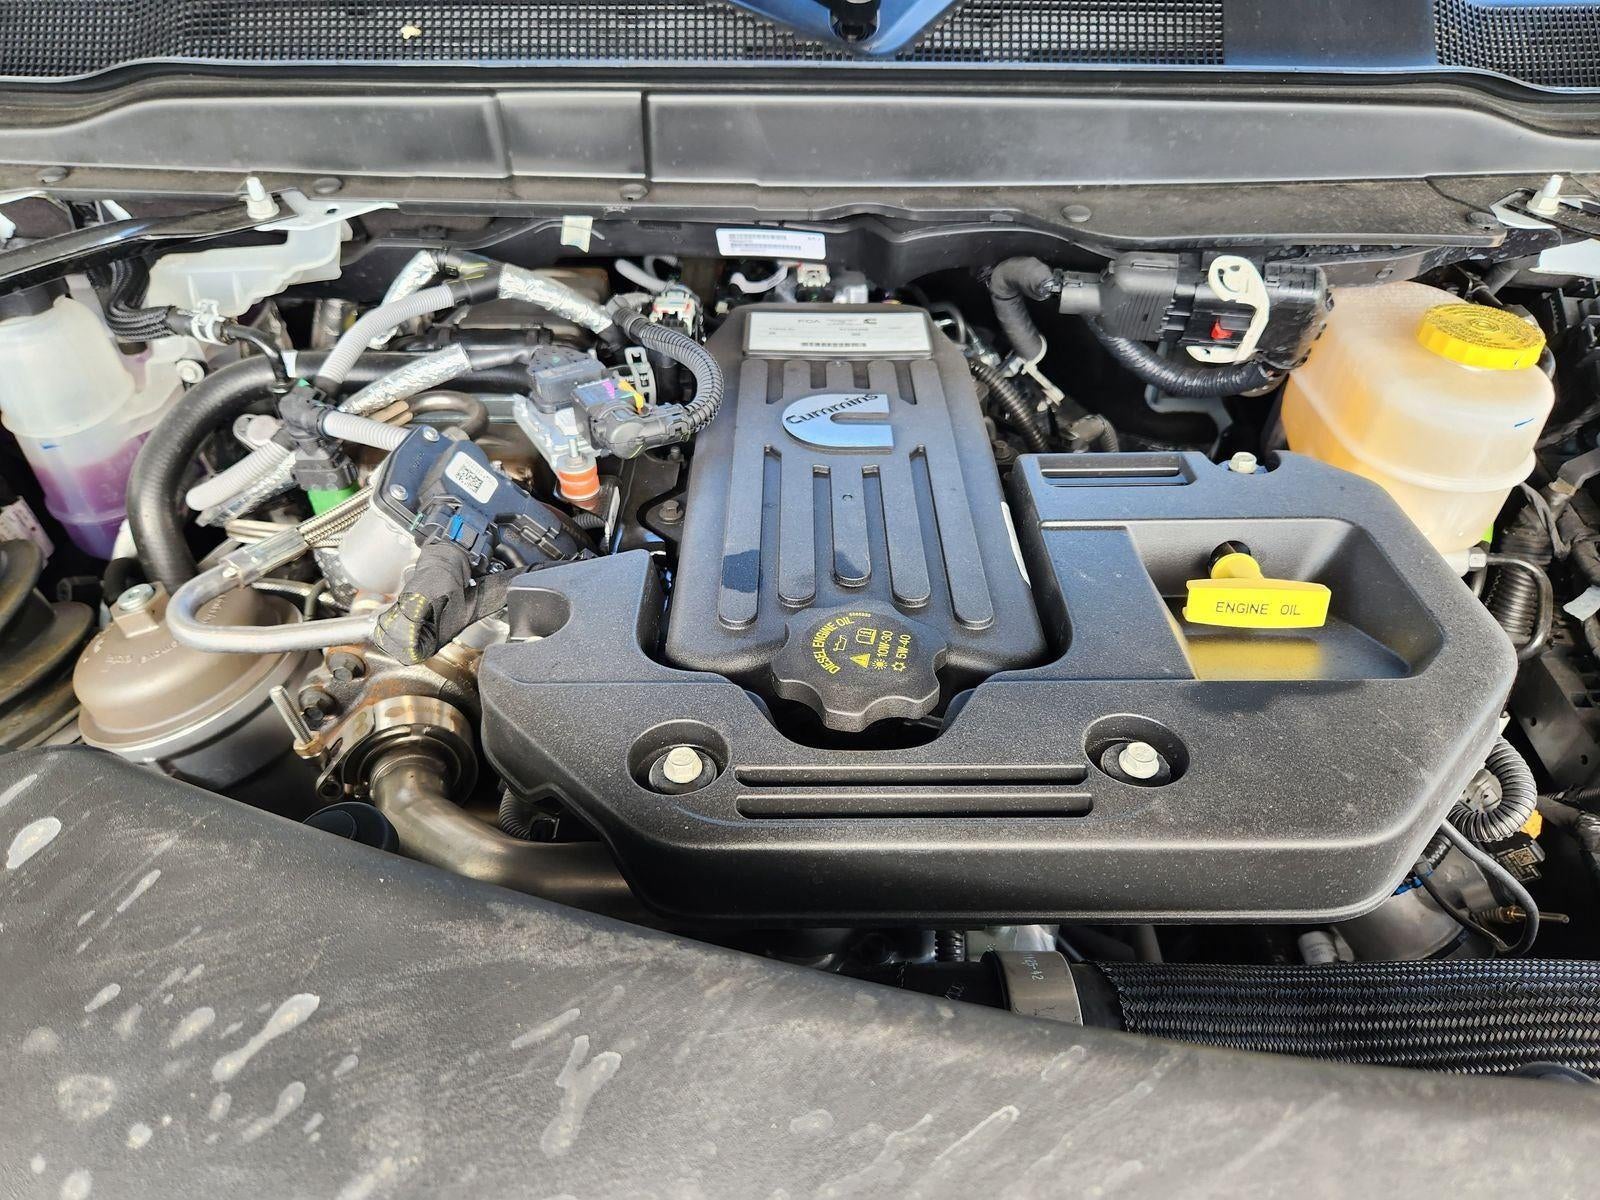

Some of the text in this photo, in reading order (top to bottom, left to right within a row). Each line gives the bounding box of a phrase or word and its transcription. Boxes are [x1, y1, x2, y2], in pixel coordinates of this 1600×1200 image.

[785, 393, 879, 424] Cummins
[1215, 601, 1301, 616] ENGINE OIL
[812, 616, 855, 674] DIESEL ENGINE OIL
[876, 630, 894, 657] 10W-30
[896, 634, 912, 660] 5W-40
